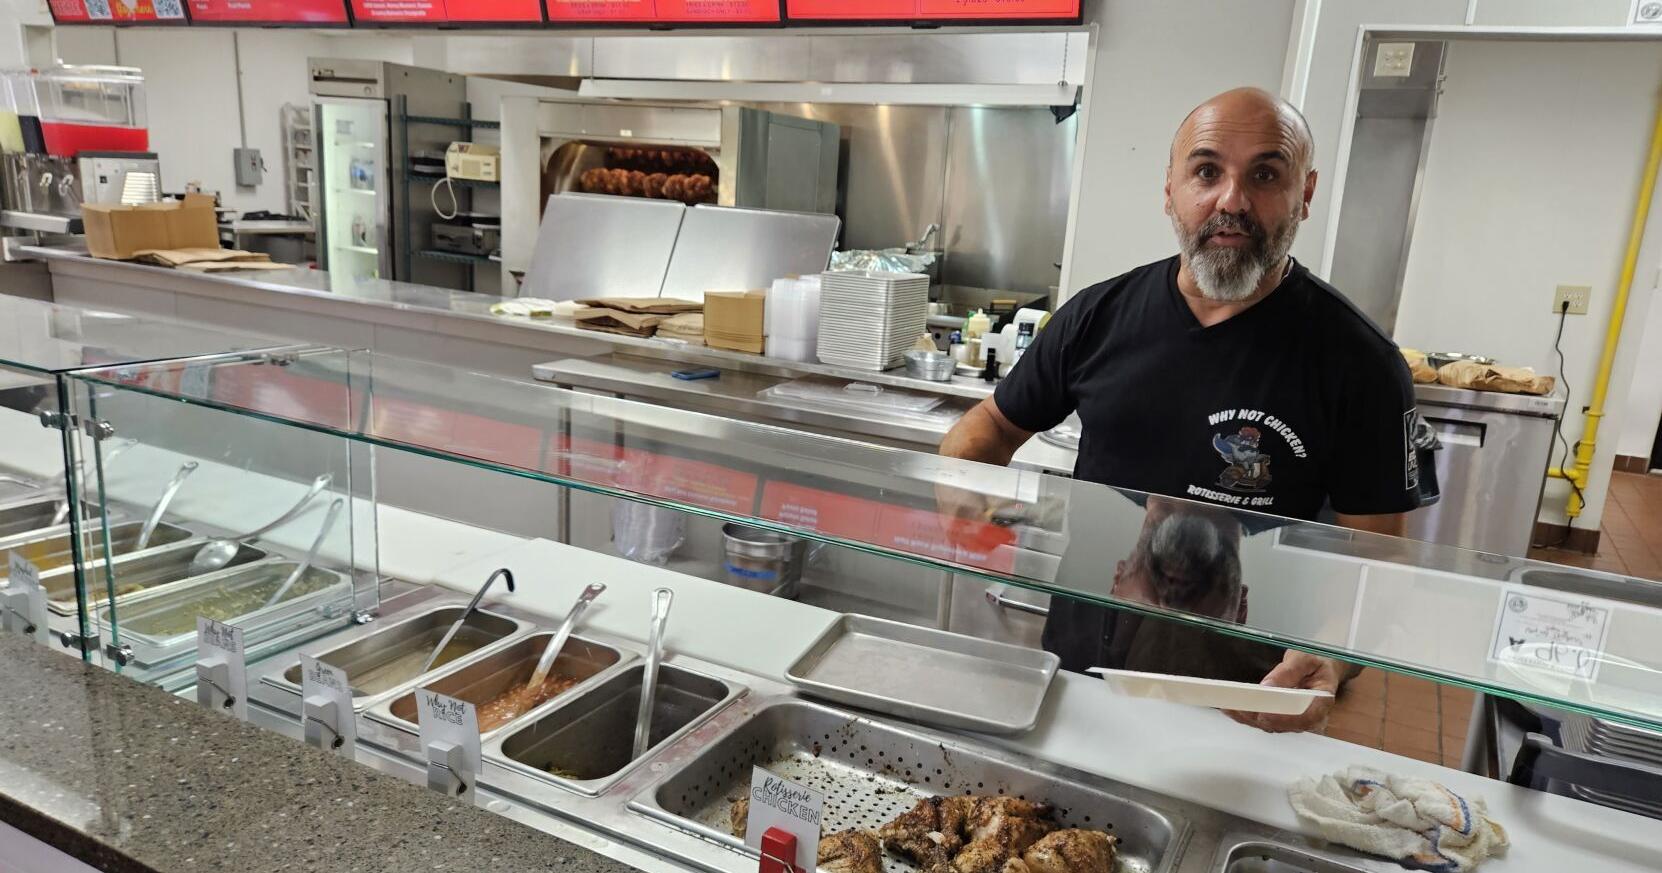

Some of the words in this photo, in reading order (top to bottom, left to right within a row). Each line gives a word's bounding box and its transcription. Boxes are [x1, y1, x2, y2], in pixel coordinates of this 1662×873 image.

[1208, 408, 1237, 426] WHY
[1237, 408, 1266, 422] NOT
[1263, 415, 1307, 458] CHICKEN?
[1187, 484, 1242, 505] ROTISSERIE
[1242, 496, 1250, 505] &
[1251, 496, 1274, 506] GRILL
[426, 694, 447, 714] Why
[448, 699, 466, 715] Not
[432, 706, 464, 726] RICE
[763, 776, 812, 802] Rotisserie
[751, 786, 820, 826] CHICKEN
